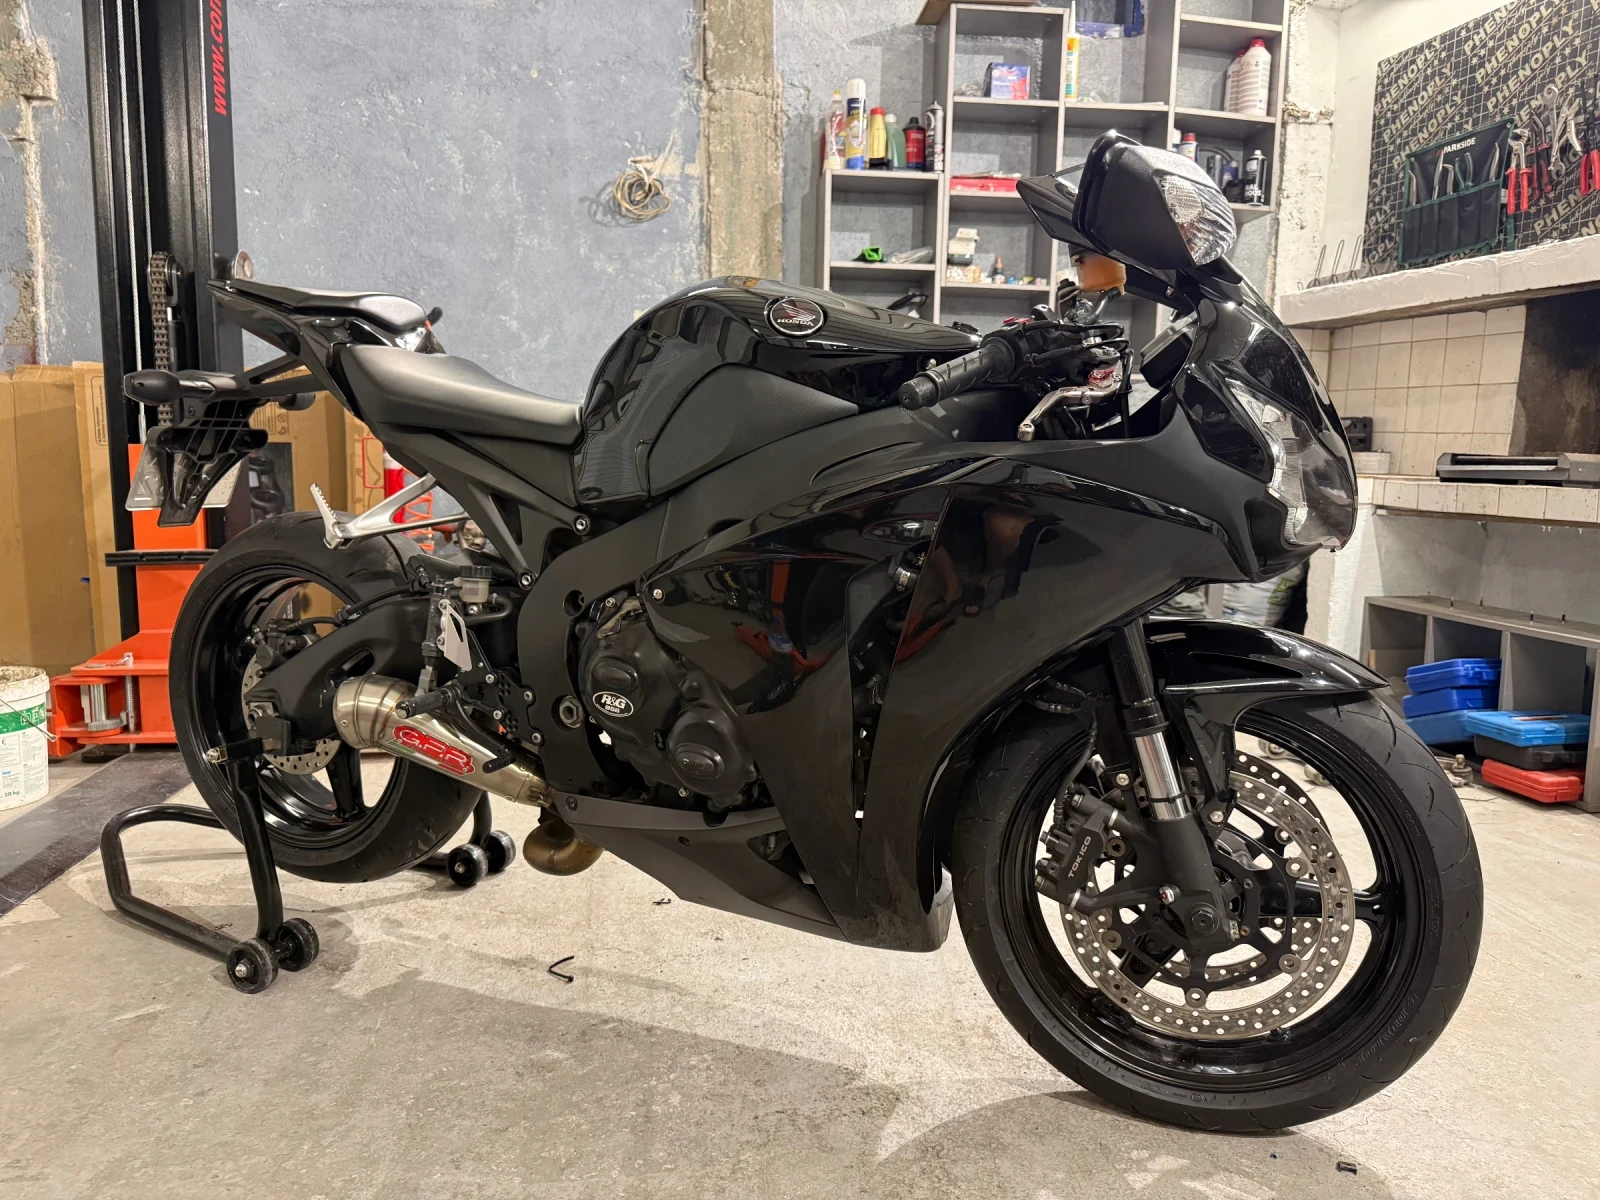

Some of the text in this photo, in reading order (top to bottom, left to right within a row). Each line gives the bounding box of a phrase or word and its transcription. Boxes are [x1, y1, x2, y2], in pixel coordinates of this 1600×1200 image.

[1464, 0, 1520, 56] PHENO
[1374, 36, 1441, 117] PHENOPLY
[1487, 19, 1574, 112] PHENOPLY
[1516, 49, 1588, 127] ENOPLY
[1383, 62, 1452, 143] PHENOPLY
[1392, 90, 1462, 170] PHENOPLY
[1443, 137, 1476, 154] PARKSIDE
[1534, 188, 1584, 235] PHEN
[777, 318, 814, 326] HONDA
[601, 694, 626, 709] R&G
[1068, 836, 1091, 878] TOKICO
